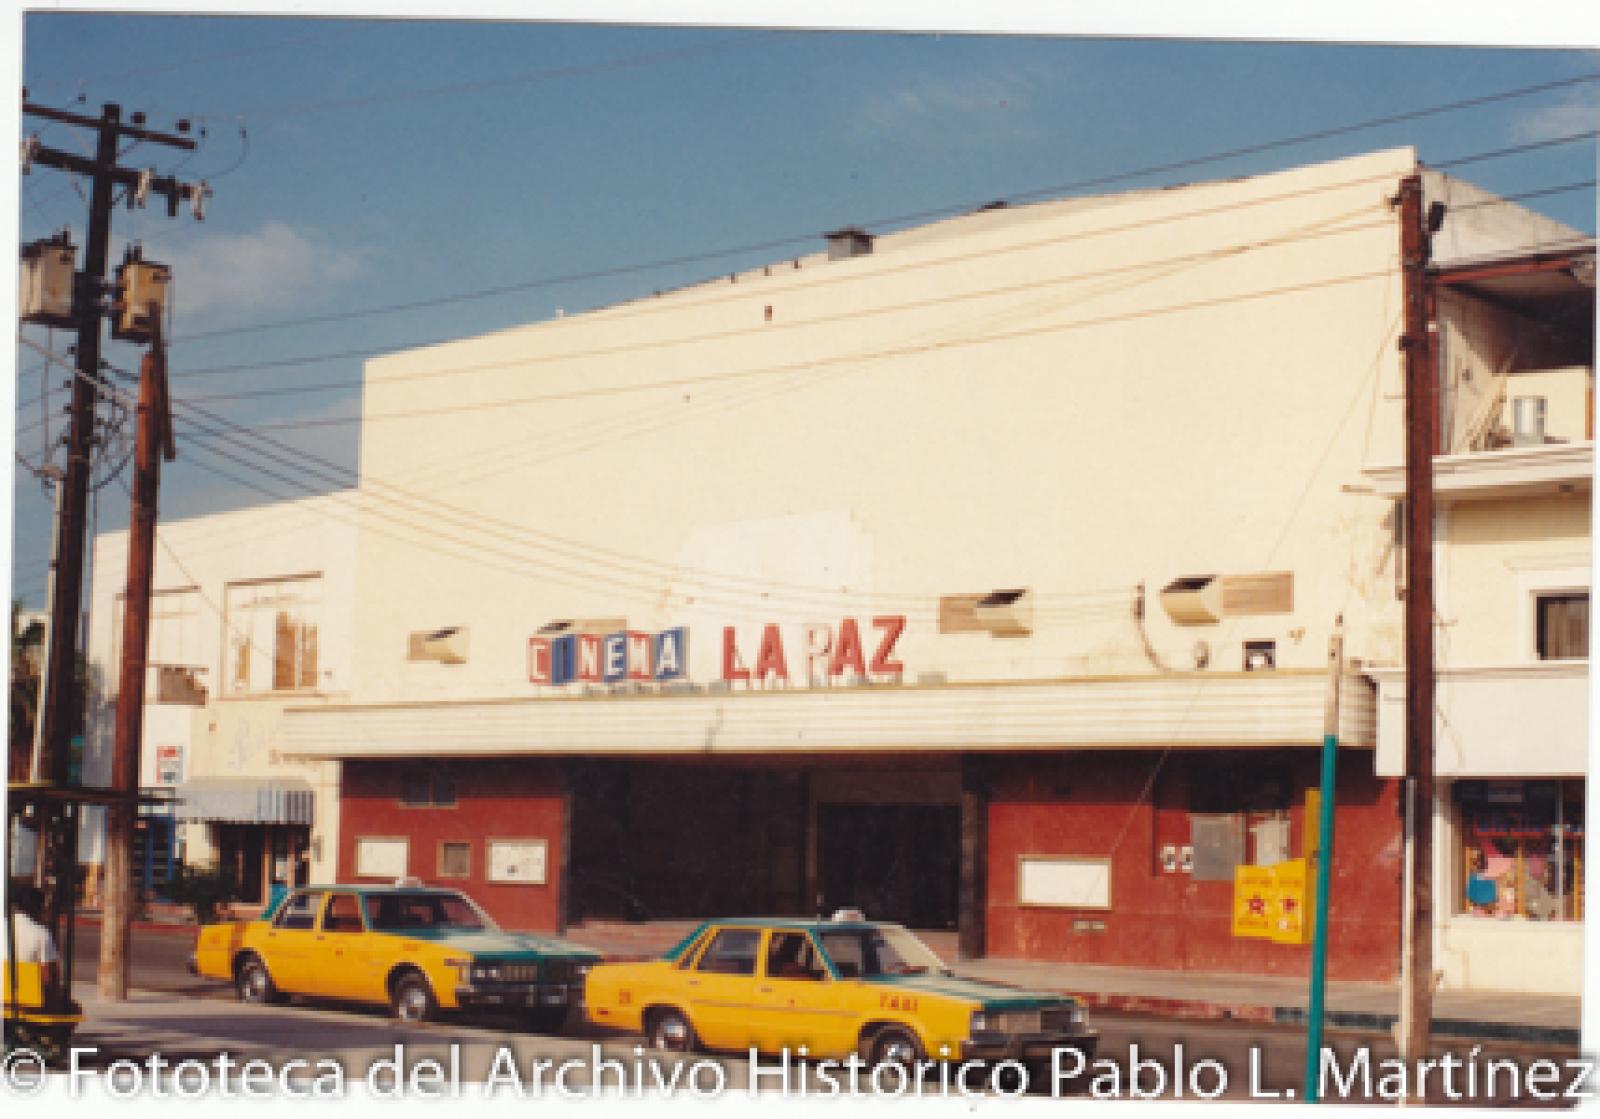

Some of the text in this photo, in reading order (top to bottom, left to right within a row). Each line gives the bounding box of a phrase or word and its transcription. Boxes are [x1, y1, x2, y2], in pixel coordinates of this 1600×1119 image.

[529, 616, 906, 685] CINEMA LA PAZ
